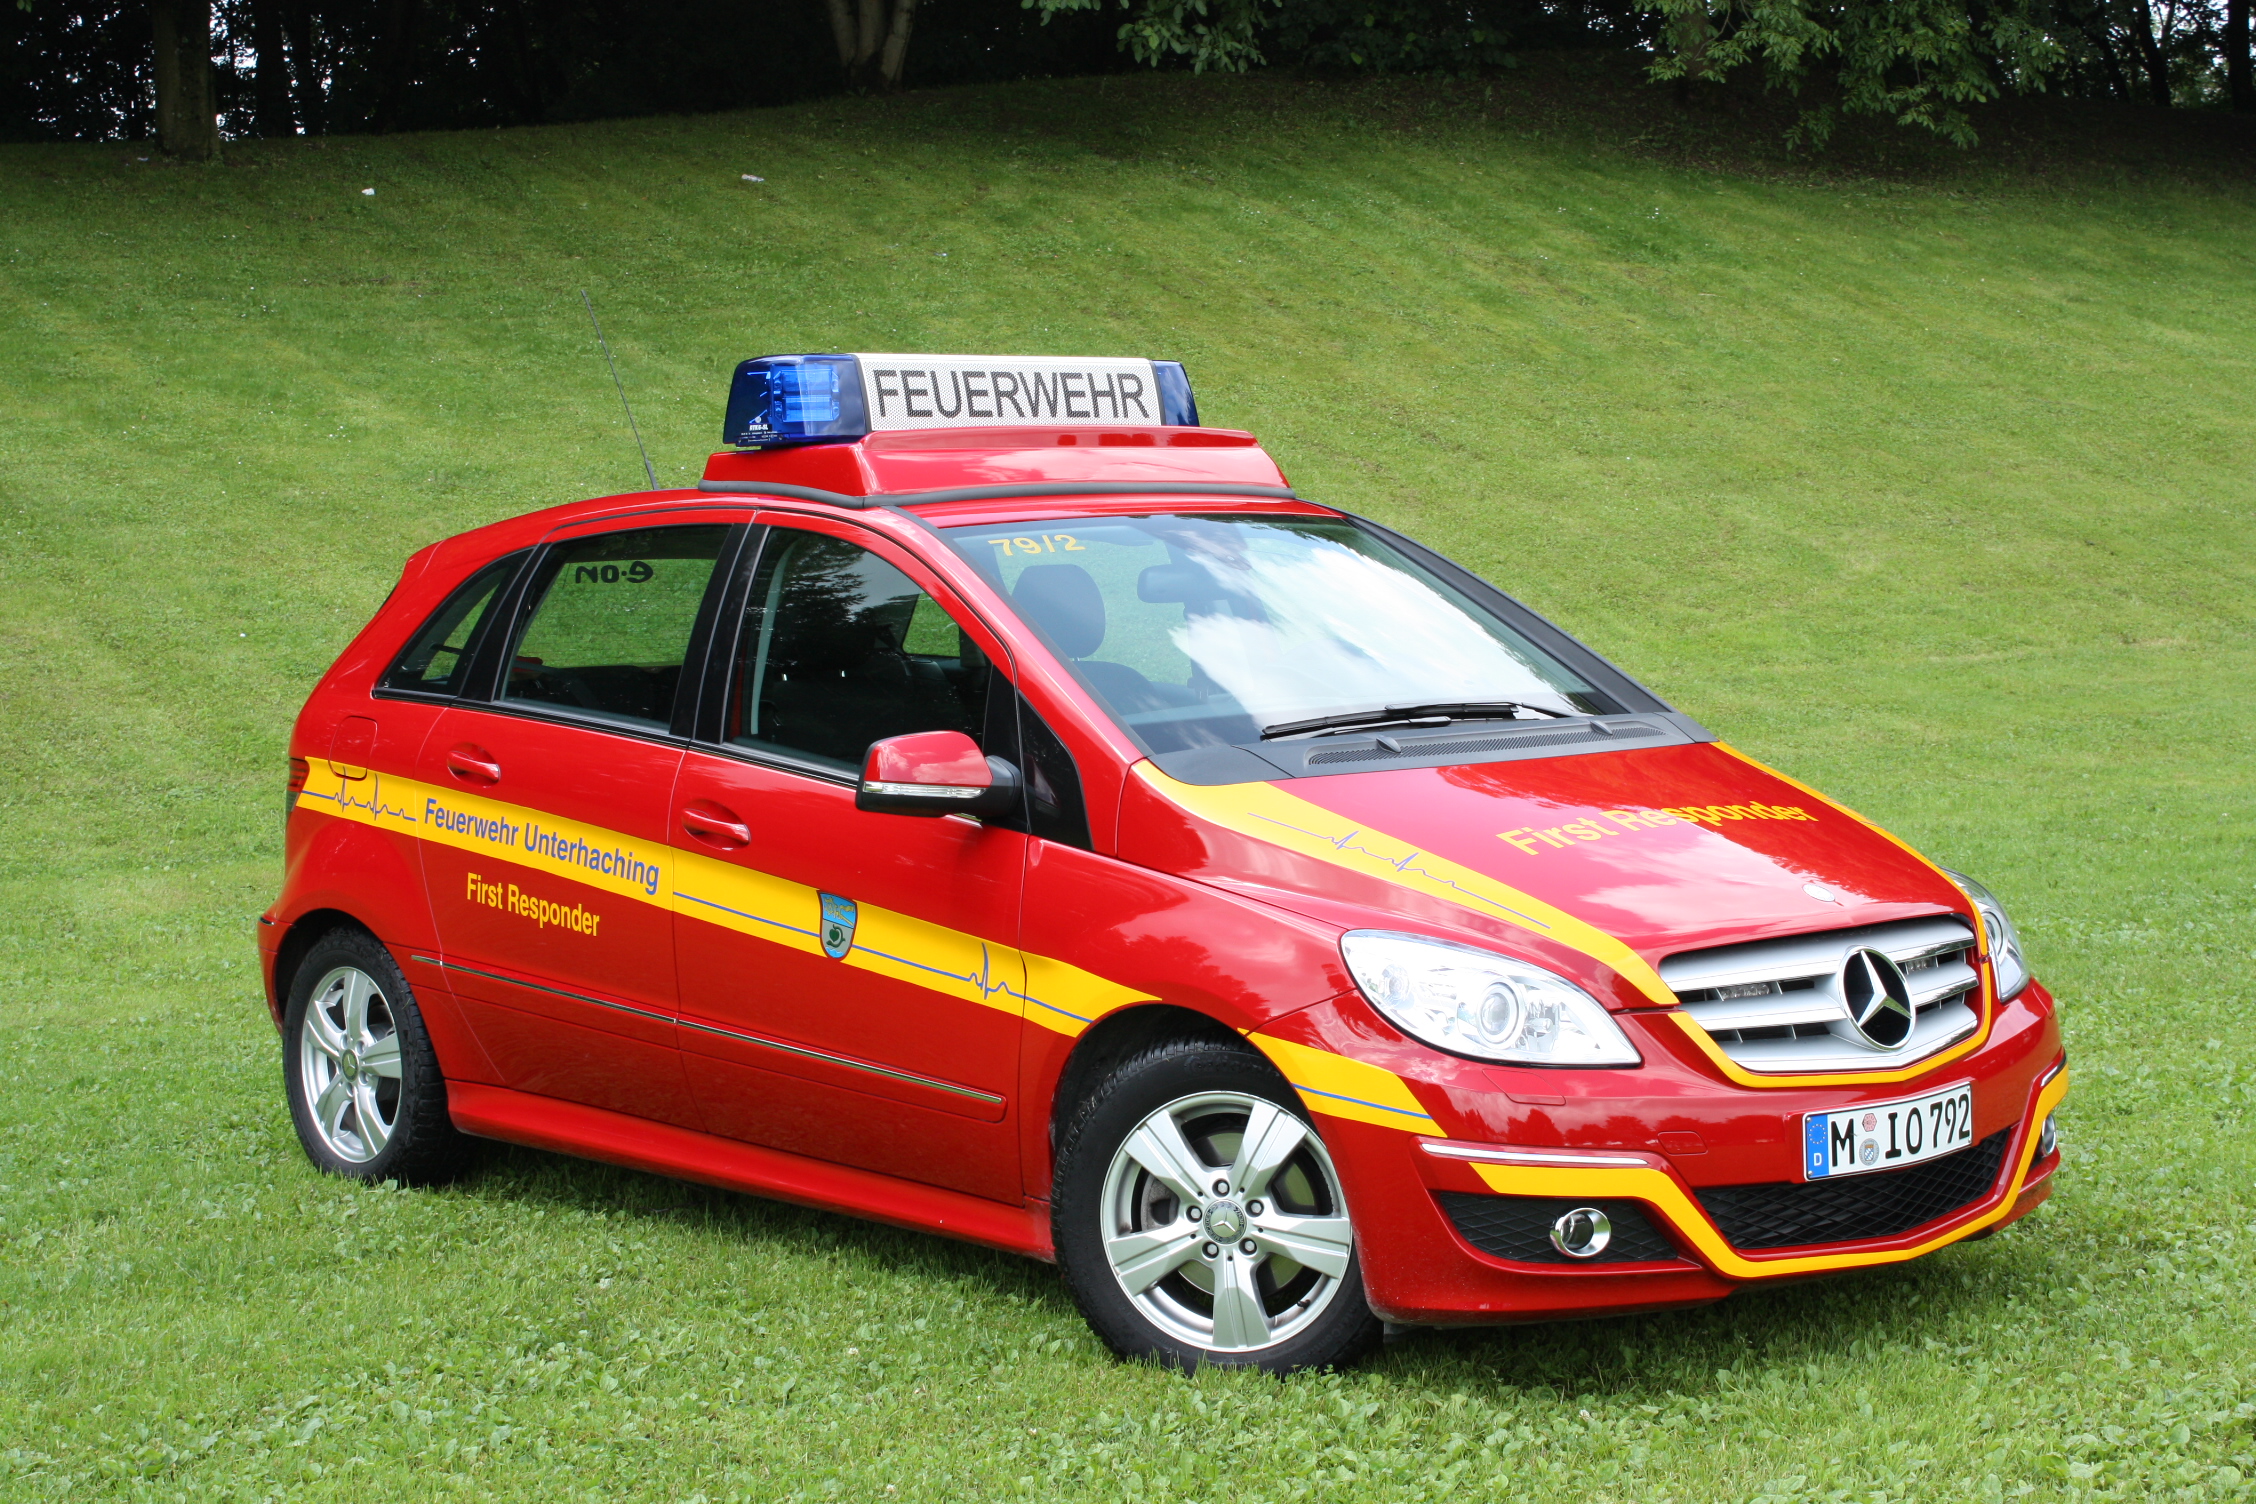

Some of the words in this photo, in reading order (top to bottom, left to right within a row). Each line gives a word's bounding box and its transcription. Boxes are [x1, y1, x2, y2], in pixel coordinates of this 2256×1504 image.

[873, 369, 1149, 419] FEUERWEHR
[988, 534, 1086, 556] 79/2
[425, 798, 520, 846] Feuerwehr
[525, 823, 660, 895] Unterhaching
[1496, 817, 1620, 855] First
[1599, 801, 1819, 832] Responder
[467, 872, 503, 910] First
[508, 884, 599, 936] Responder
[1831, 1118, 1855, 1167] M
[1930, 1093, 1971, 1148] 792
[1813, 1152, 1823, 1166] D
